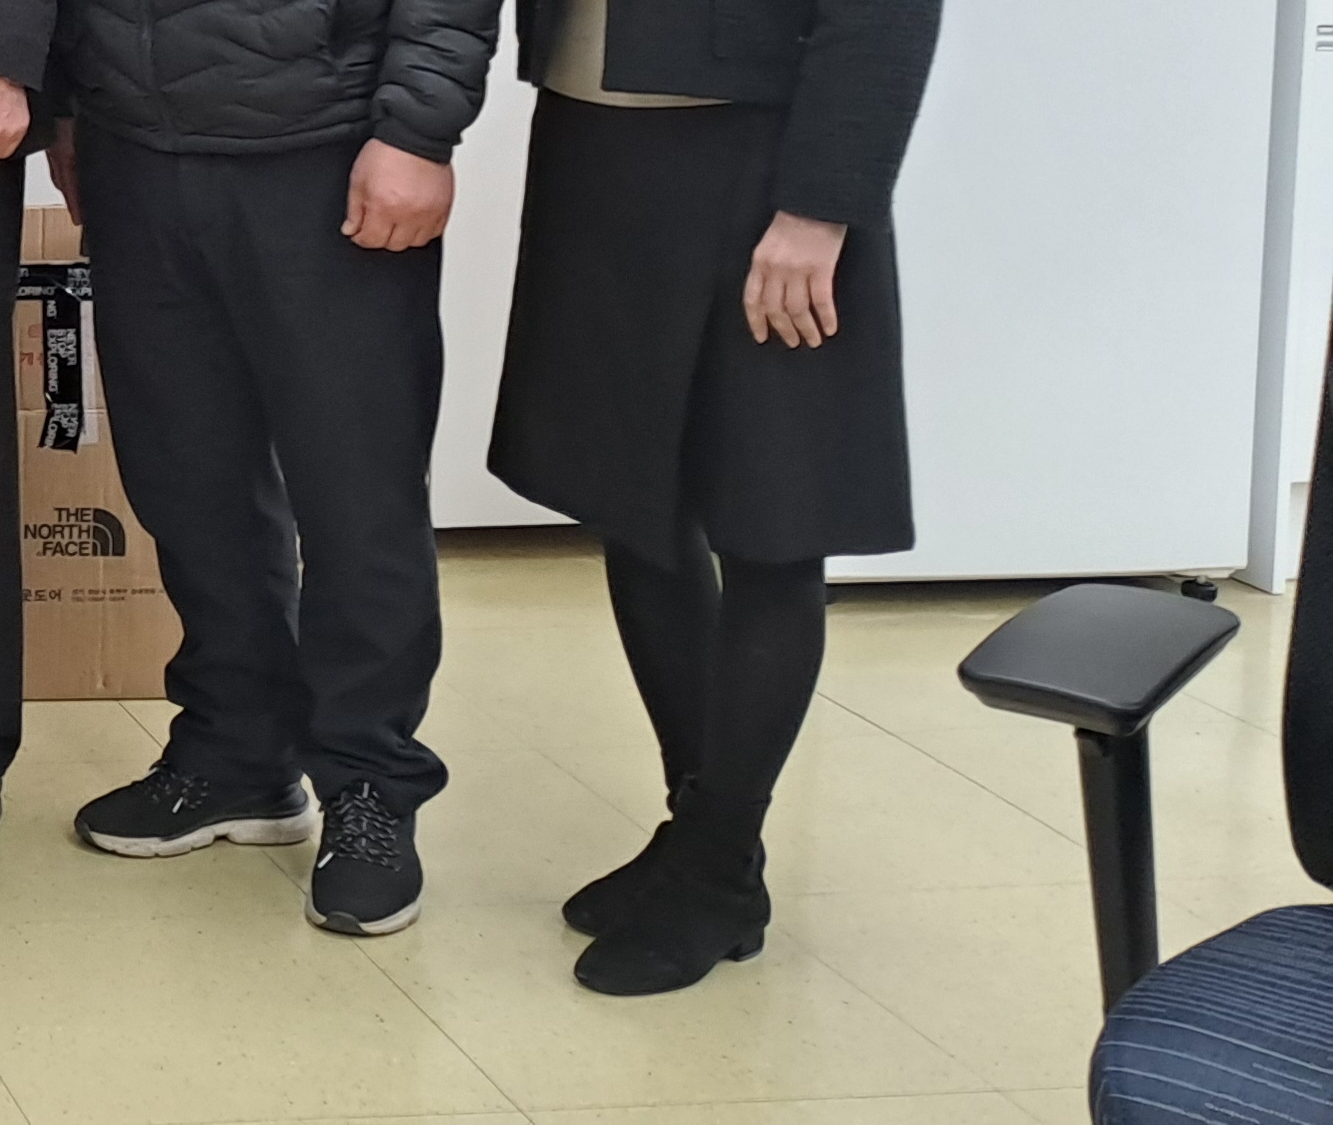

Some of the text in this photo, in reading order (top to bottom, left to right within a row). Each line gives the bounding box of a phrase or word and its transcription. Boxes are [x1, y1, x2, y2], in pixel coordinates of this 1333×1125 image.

[67, 328, 78, 366] NEVER
[53, 507, 92, 523] THE
[23, 524, 91, 540] NORTH
[41, 541, 91, 557] FACE
